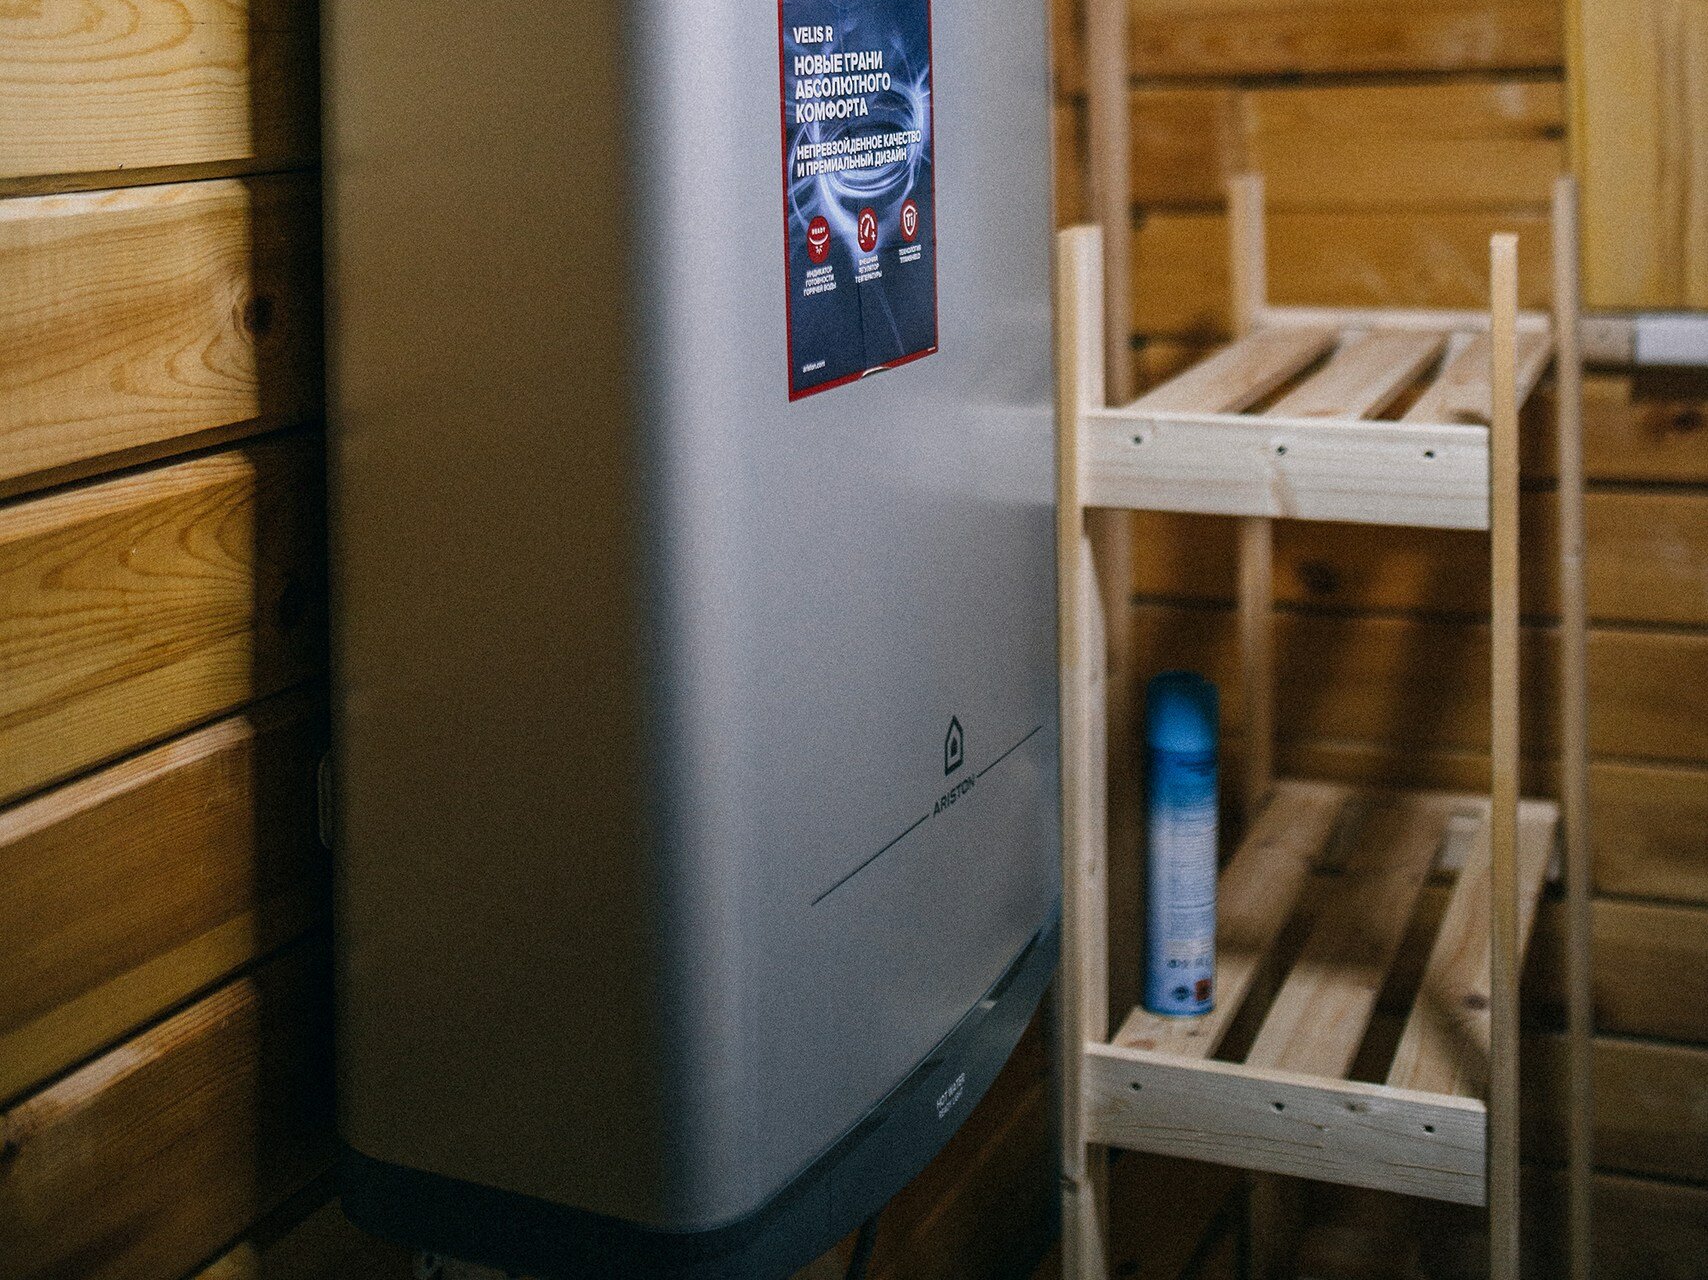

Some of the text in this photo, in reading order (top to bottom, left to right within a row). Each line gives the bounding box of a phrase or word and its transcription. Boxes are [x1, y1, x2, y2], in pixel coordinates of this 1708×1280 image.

[793, 26, 833, 44] VELIS R
[795, 51, 883, 76] НОВЫЕ ГРАНИ
[795, 72, 891, 100] АБСОЛЮТНОГО
[796, 97, 869, 123] КОМФОРТА
[797, 130, 922, 160] НЕПРЕВЗОЙДЕННОЕ КАЧЕСТВО
[797, 146, 907, 177] И ПРЕМИАЛЬНЫЙ ДИЗАЙН
[933, 773, 976, 818] ARISTON
